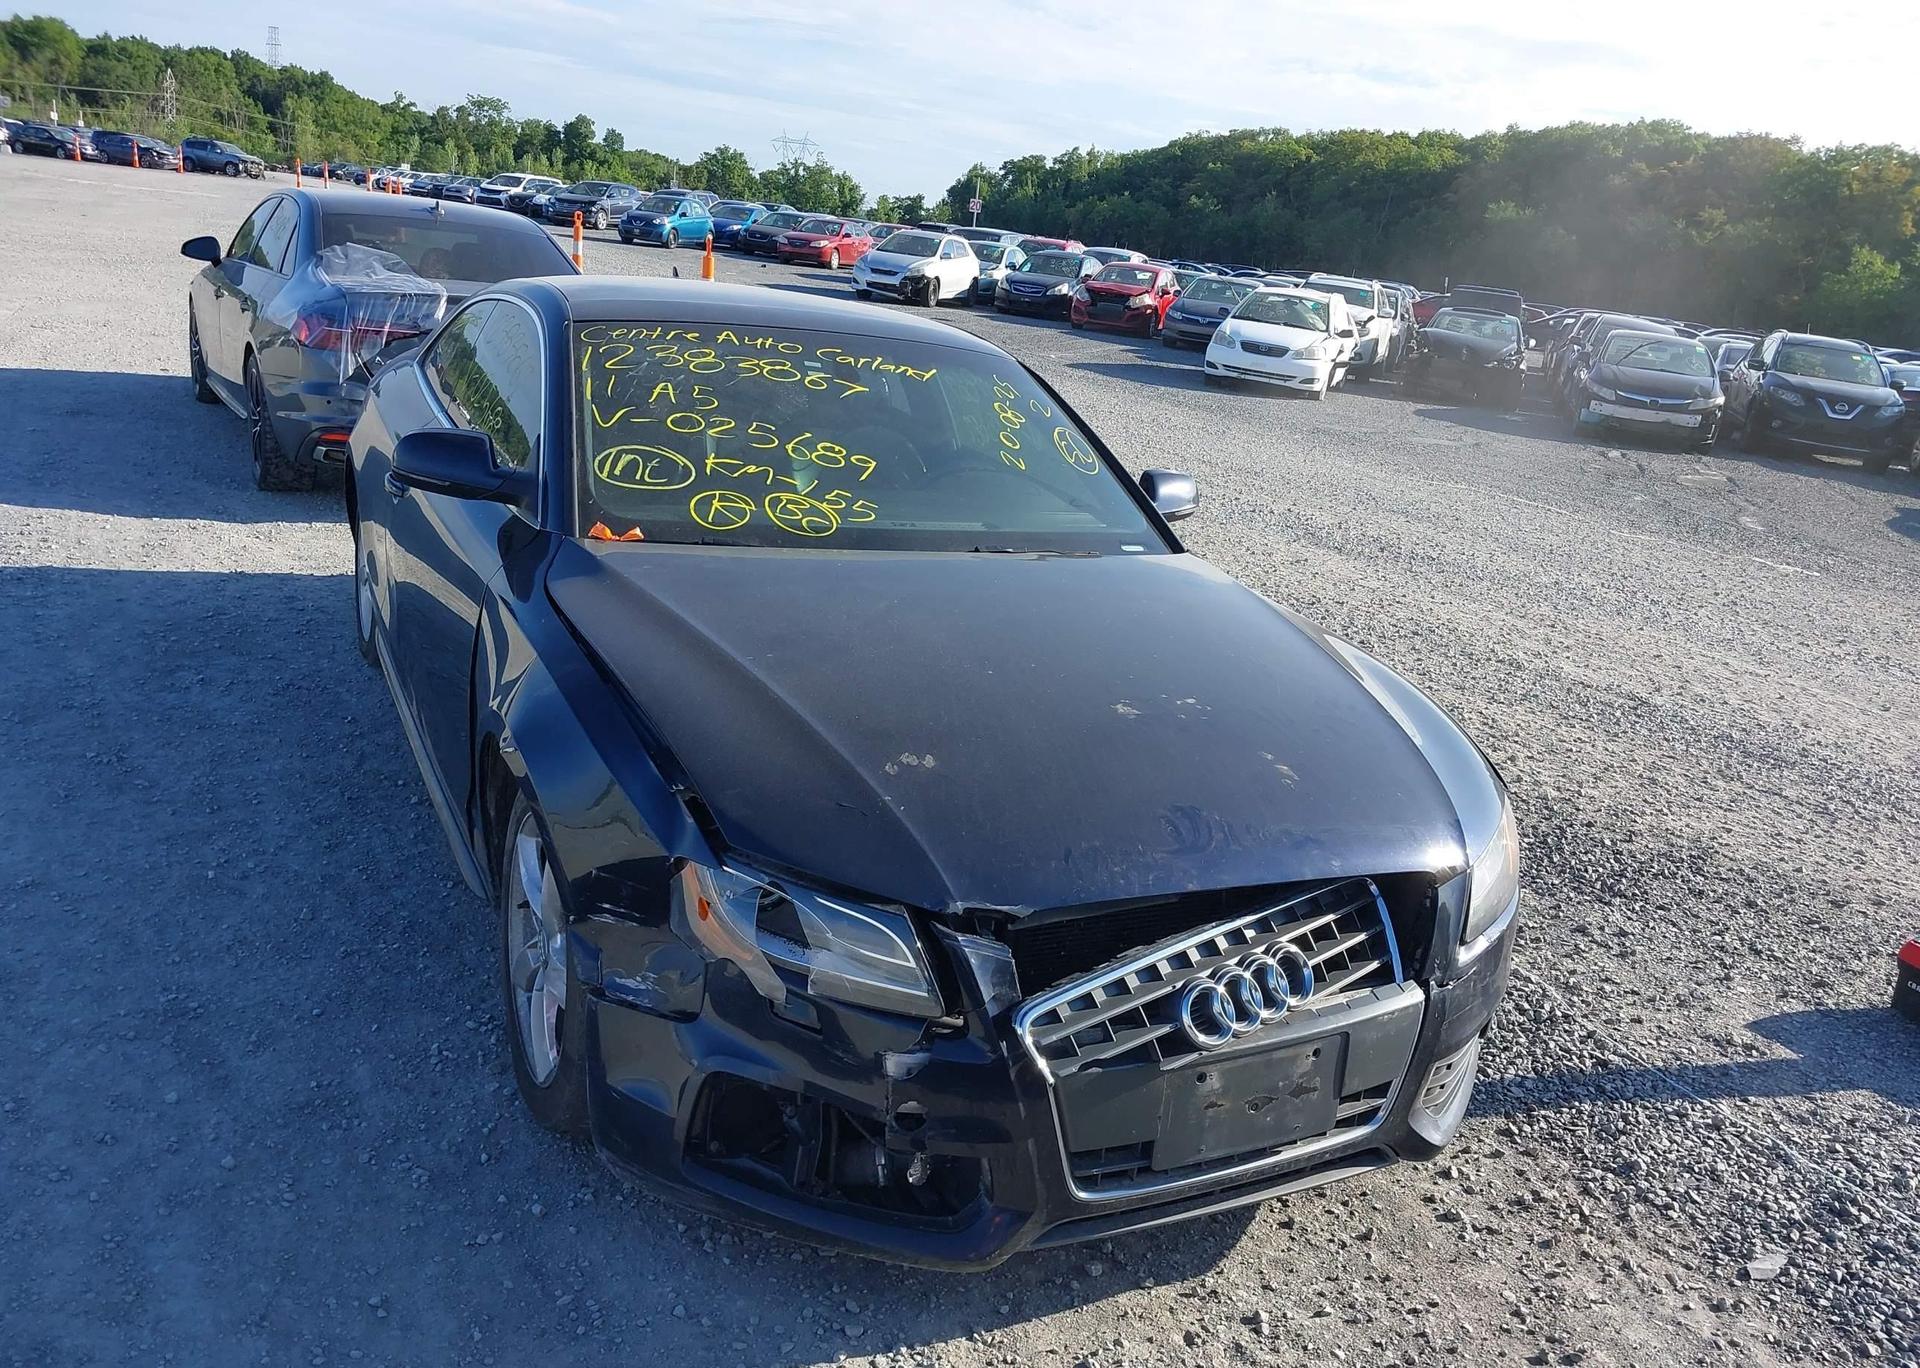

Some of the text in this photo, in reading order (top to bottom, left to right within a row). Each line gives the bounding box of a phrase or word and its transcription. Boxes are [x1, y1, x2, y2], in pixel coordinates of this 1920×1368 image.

[970, 201, 981, 212] 20
[580, 325, 938, 381] Centre Auto Carland
[582, 344, 870, 399] 12383867
